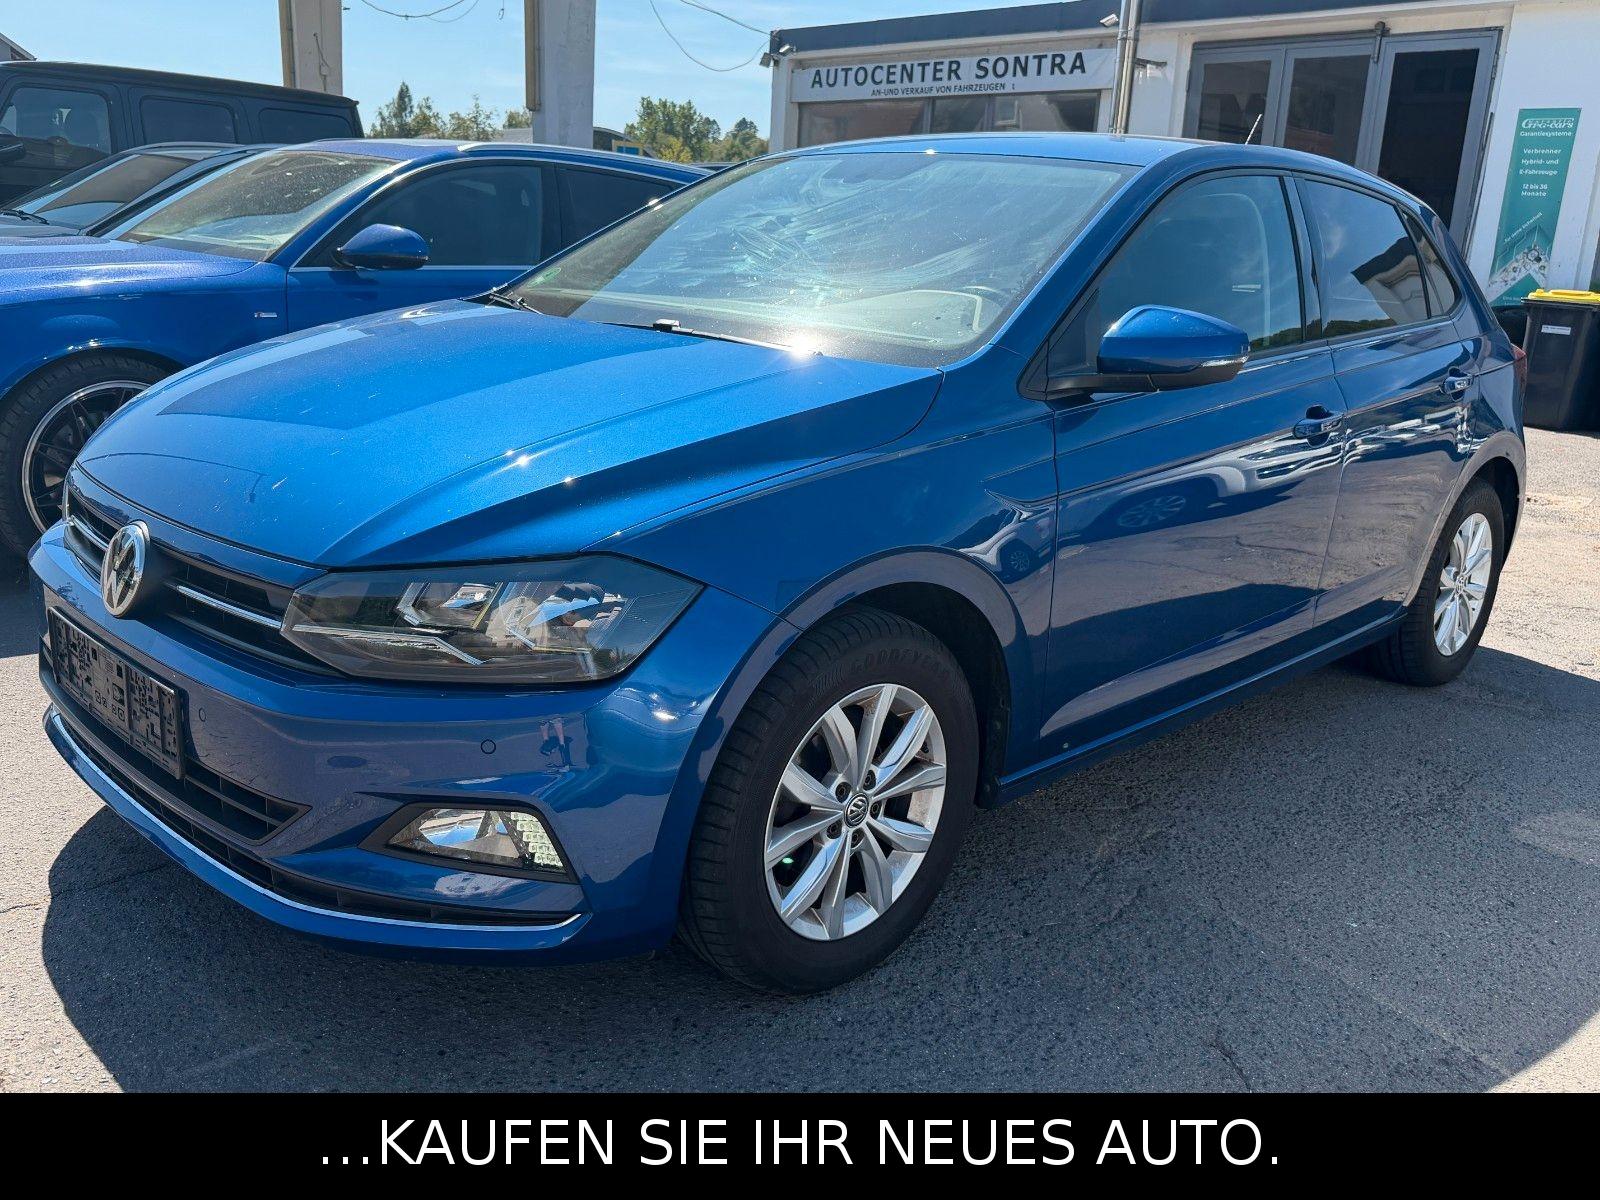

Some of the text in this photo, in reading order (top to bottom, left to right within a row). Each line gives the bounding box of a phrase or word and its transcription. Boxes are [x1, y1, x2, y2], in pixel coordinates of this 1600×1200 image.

[811, 52, 1086, 88] AUTOCENTER SONTRA
[901, 86, 934, 95] VERKAUF
[936, 85, 951, 94] VON
[953, 82, 1006, 93] FAHRZEUGEN
